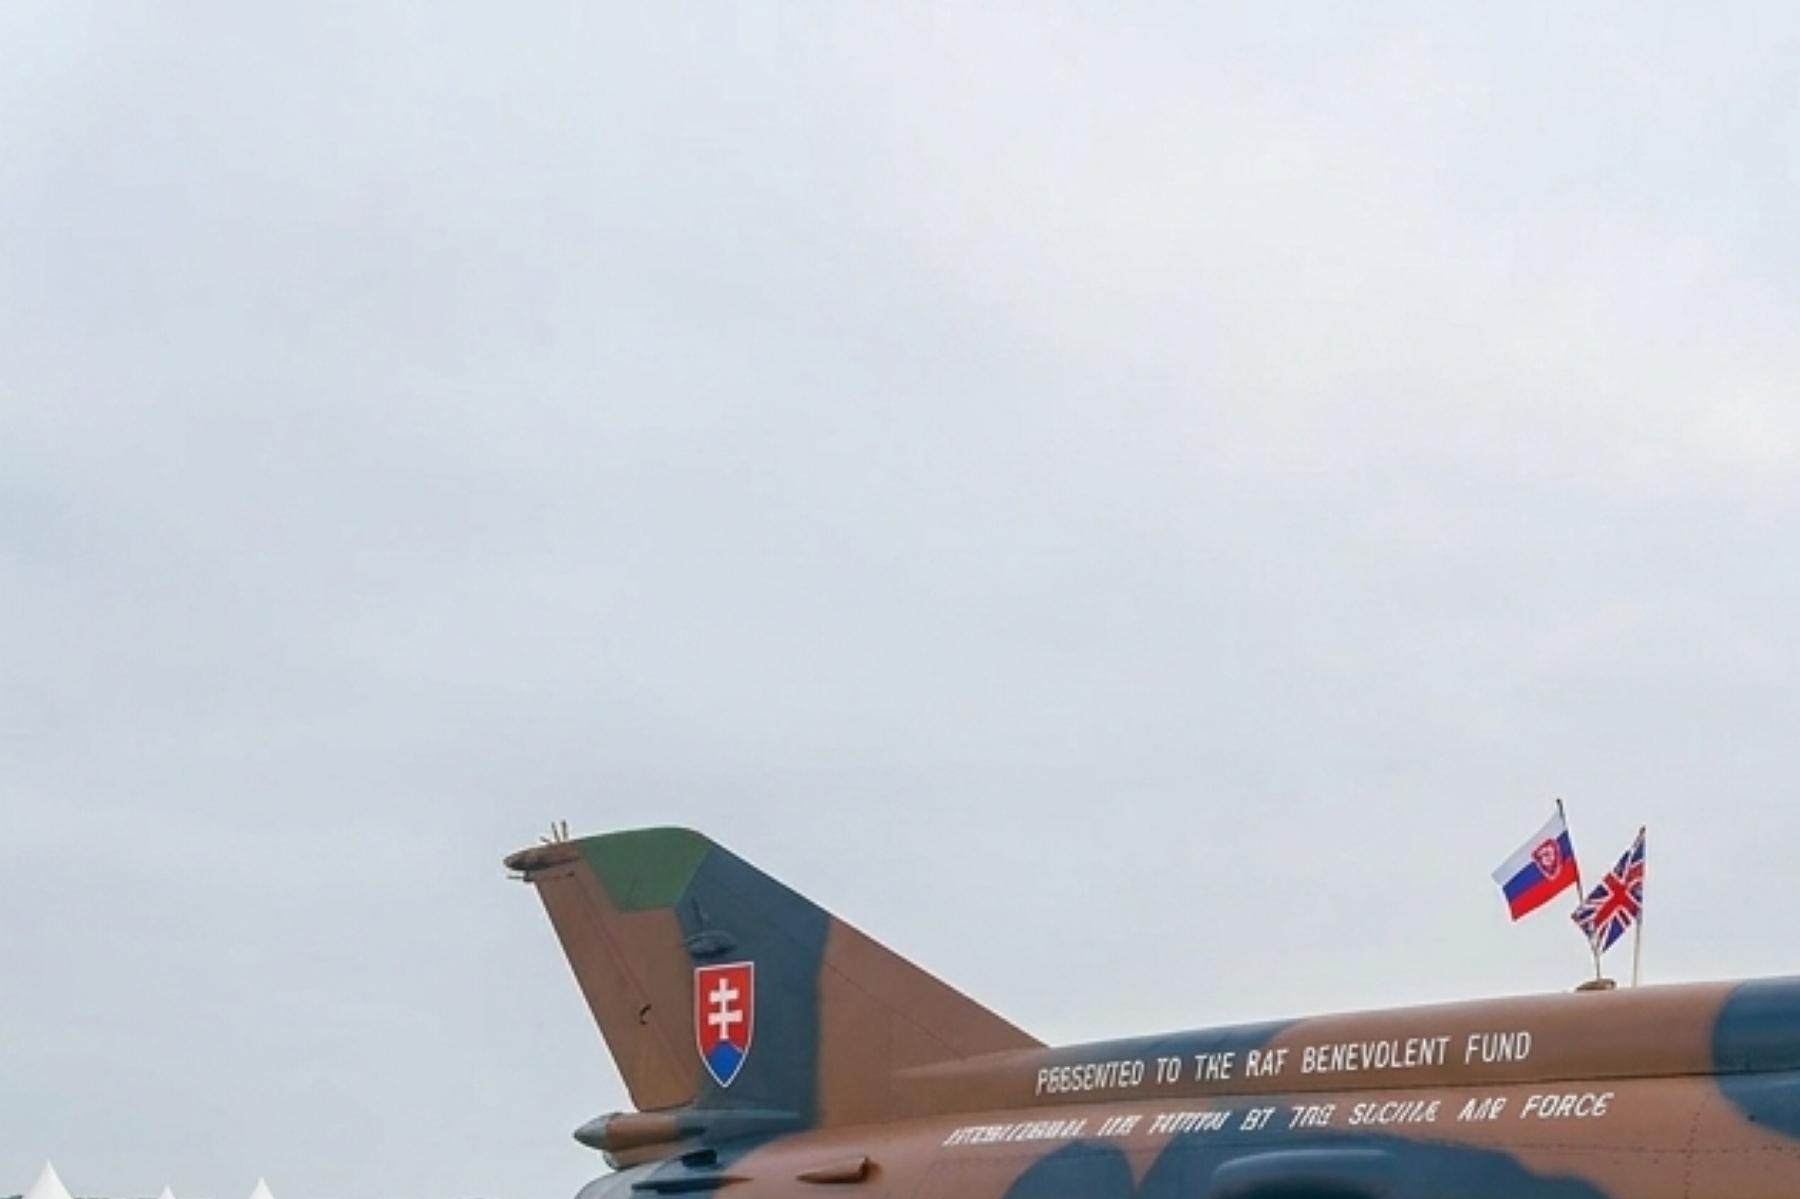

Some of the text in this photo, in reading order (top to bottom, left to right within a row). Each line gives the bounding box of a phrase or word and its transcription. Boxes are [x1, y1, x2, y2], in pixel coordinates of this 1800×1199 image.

[1157, 1057, 1182, 1084] TO
[1195, 1052, 1236, 1081] THE
[1245, 1049, 1290, 1077] RAF
[1301, 1034, 1451, 1074] BENEVOLENT
[1465, 1031, 1532, 1064] FUND
[1520, 1092, 1615, 1120] FORCE
